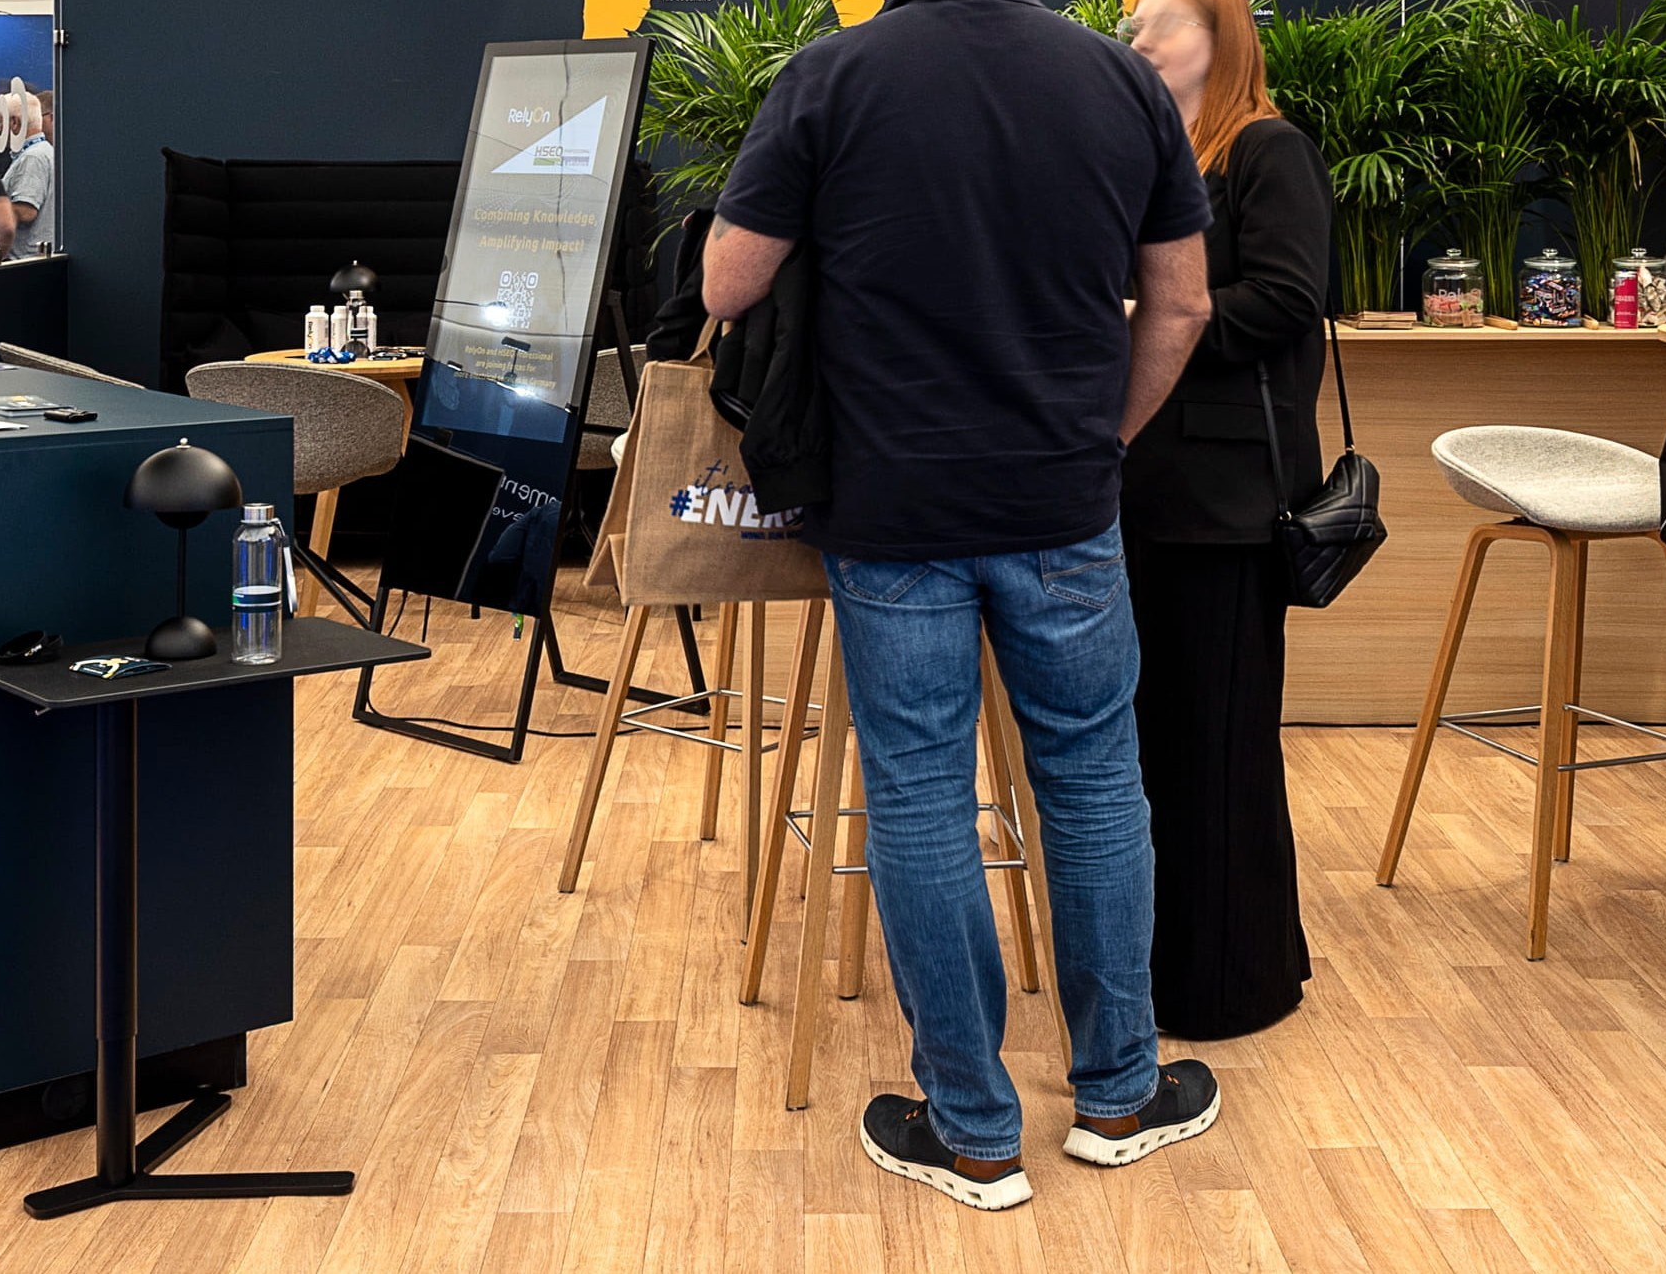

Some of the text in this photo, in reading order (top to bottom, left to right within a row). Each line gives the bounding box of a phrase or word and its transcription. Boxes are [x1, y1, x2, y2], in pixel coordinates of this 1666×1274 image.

[508, 106, 551, 127] RelyOn
[474, 208, 597, 227] Combining Knowledge,
[479, 235, 539, 252] Amplifying
